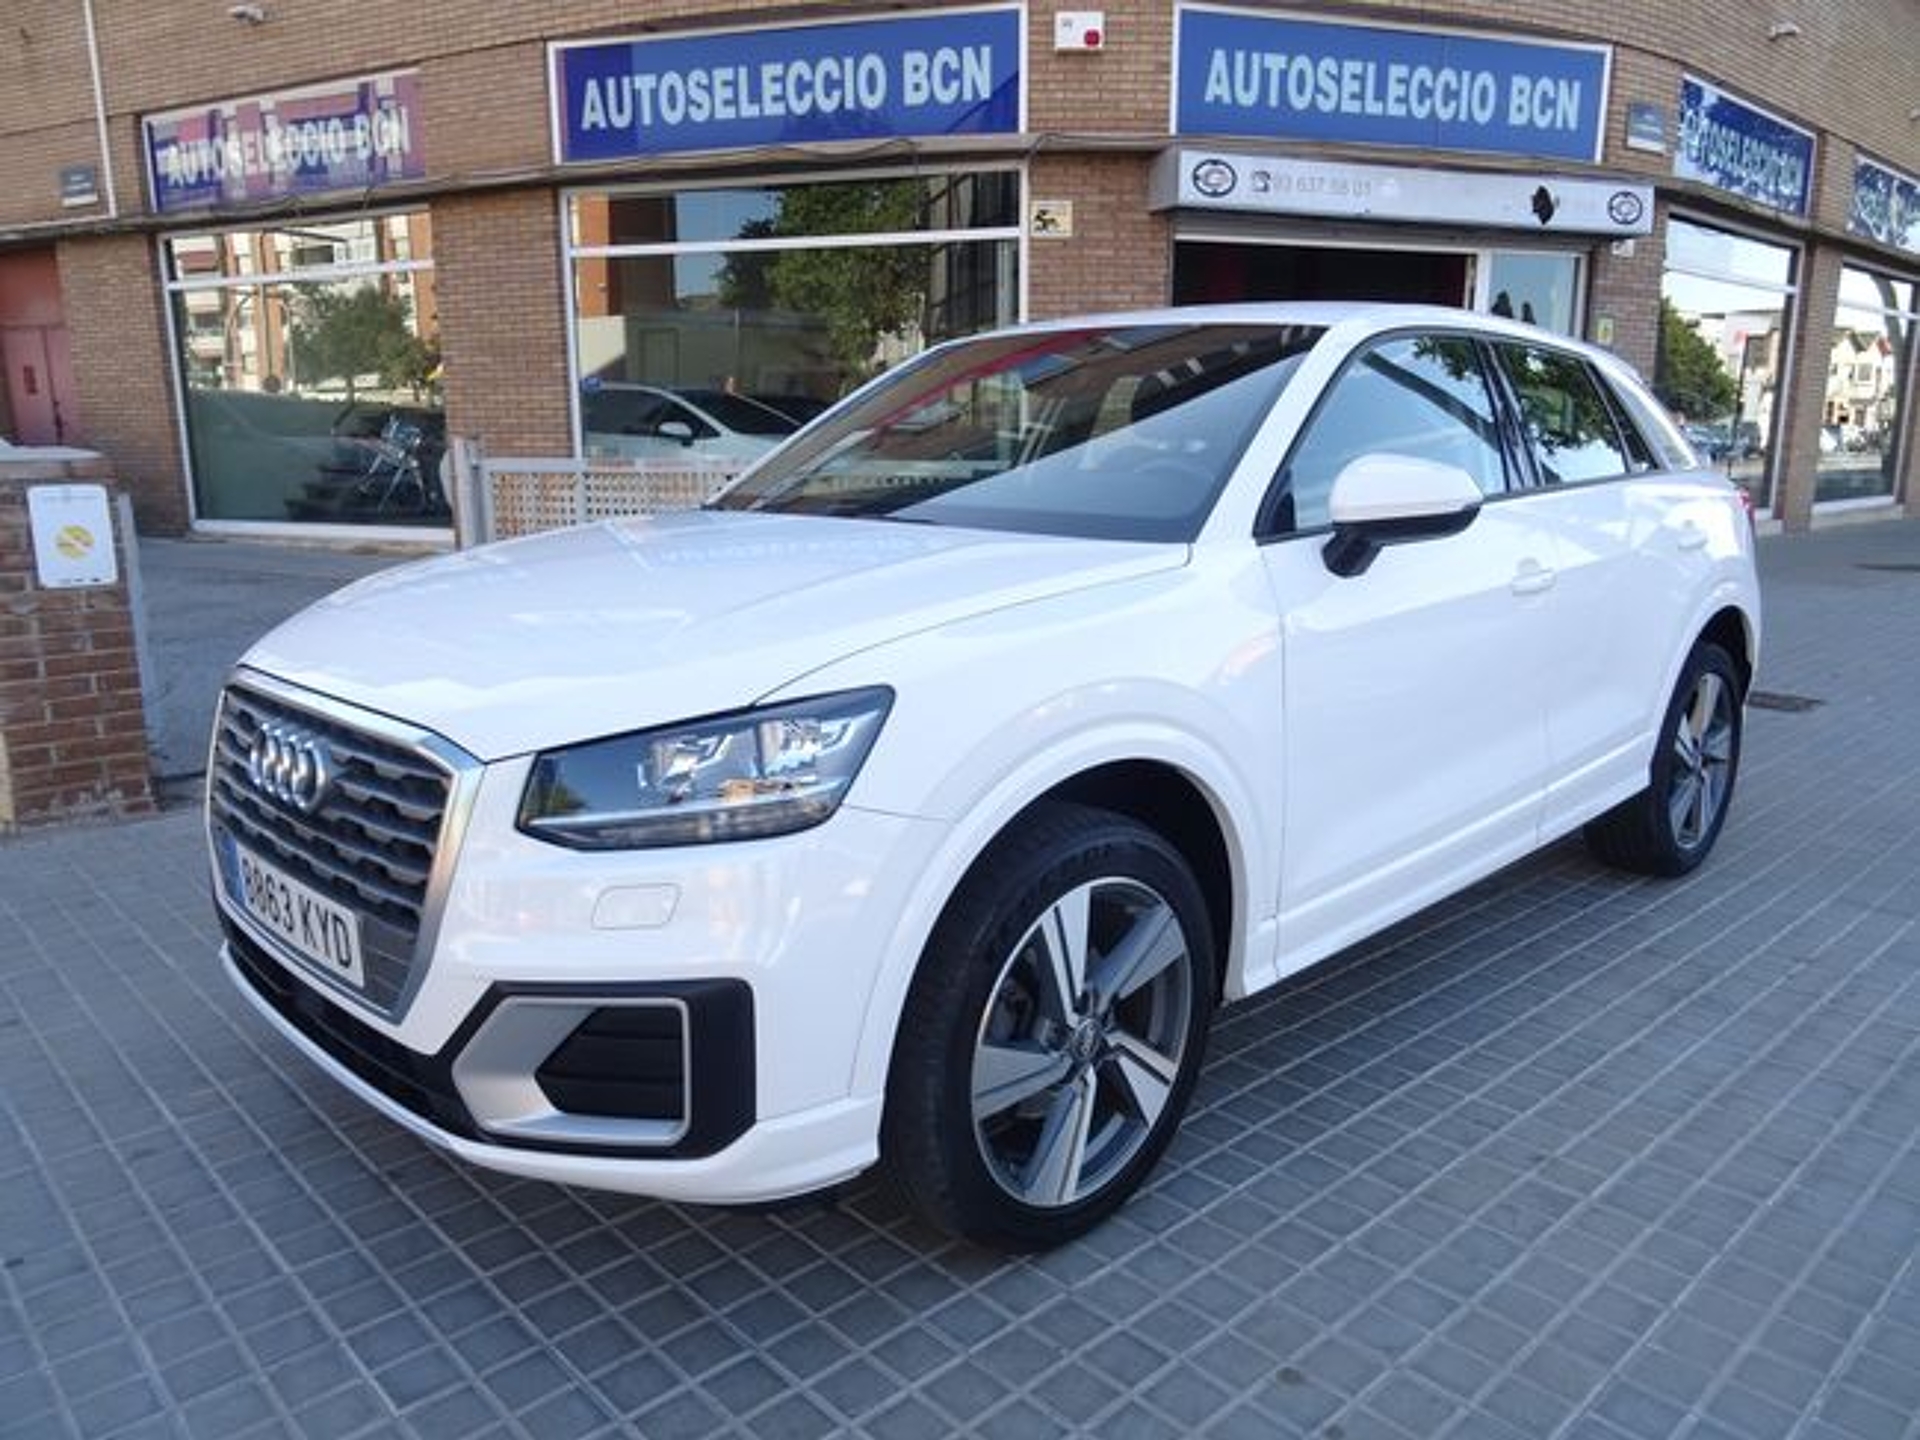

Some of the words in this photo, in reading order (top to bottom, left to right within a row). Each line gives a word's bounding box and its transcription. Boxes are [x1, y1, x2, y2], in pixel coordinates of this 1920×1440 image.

[582, 53, 887, 130] AUTOSELECCIO
[903, 46, 991, 107] BCN
[1205, 49, 1496, 124] AUTOSELECCIO
[1508, 75, 1582, 130] BCN
[299, 893, 352, 968] KYD
